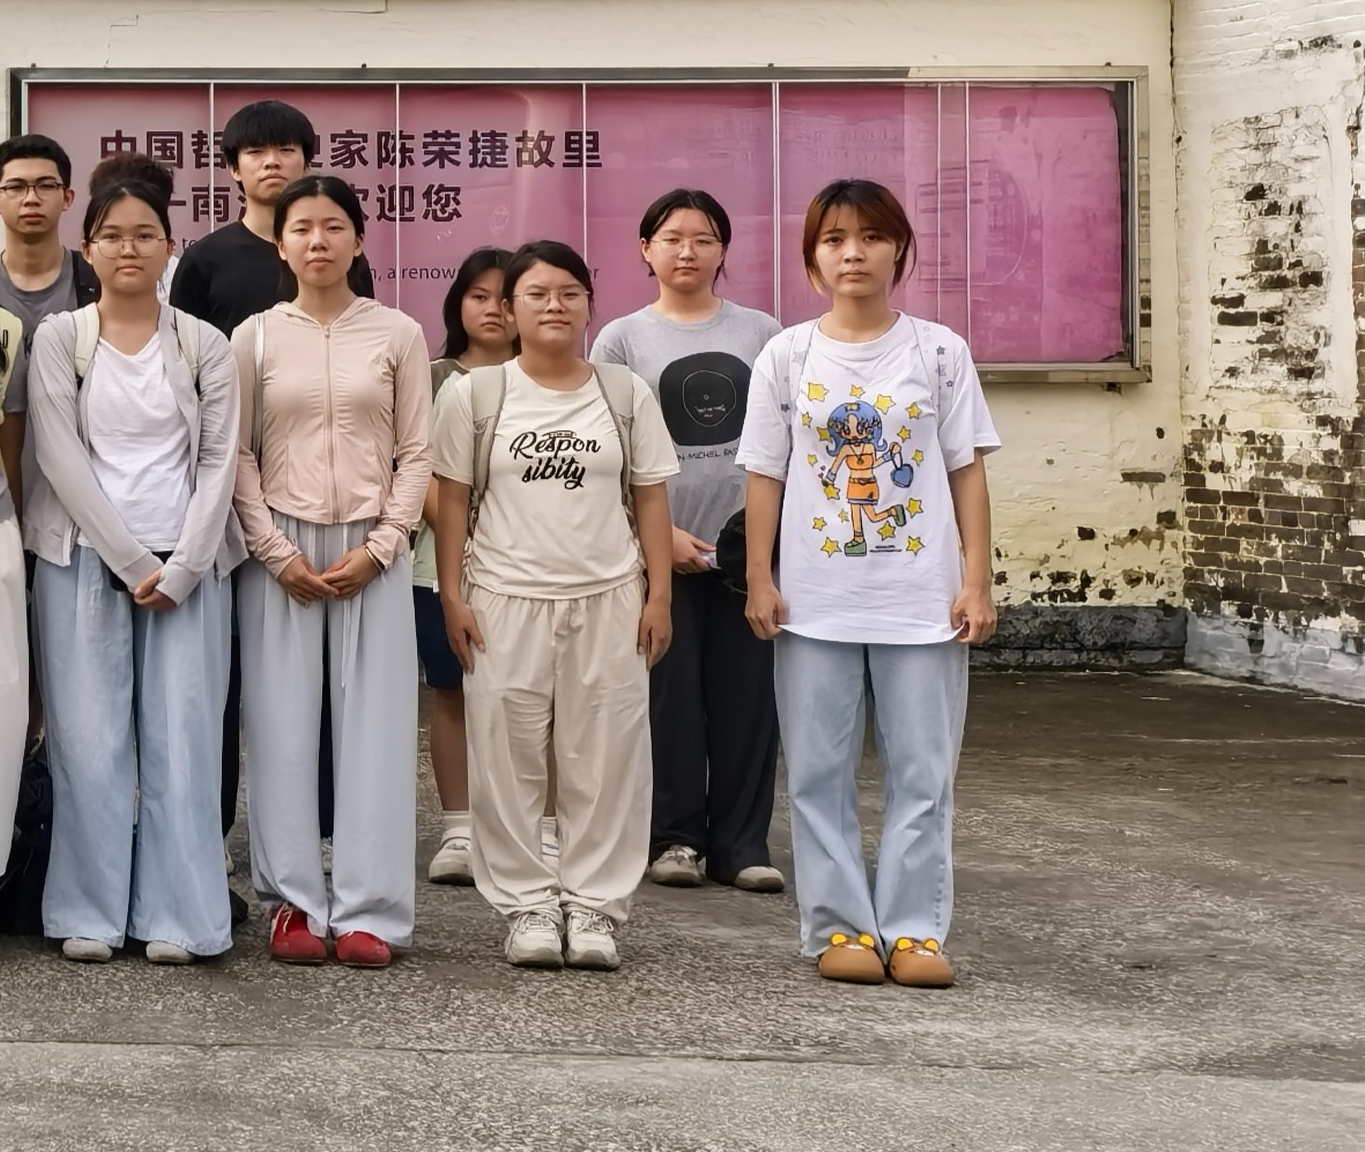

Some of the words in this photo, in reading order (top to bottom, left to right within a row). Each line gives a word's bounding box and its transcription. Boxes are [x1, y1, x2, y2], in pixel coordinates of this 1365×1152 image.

[100, 129, 603, 169] 中国哲家陈荣捷故里
[401, 268, 458, 280] renow
[509, 431, 601, 460] Respon
